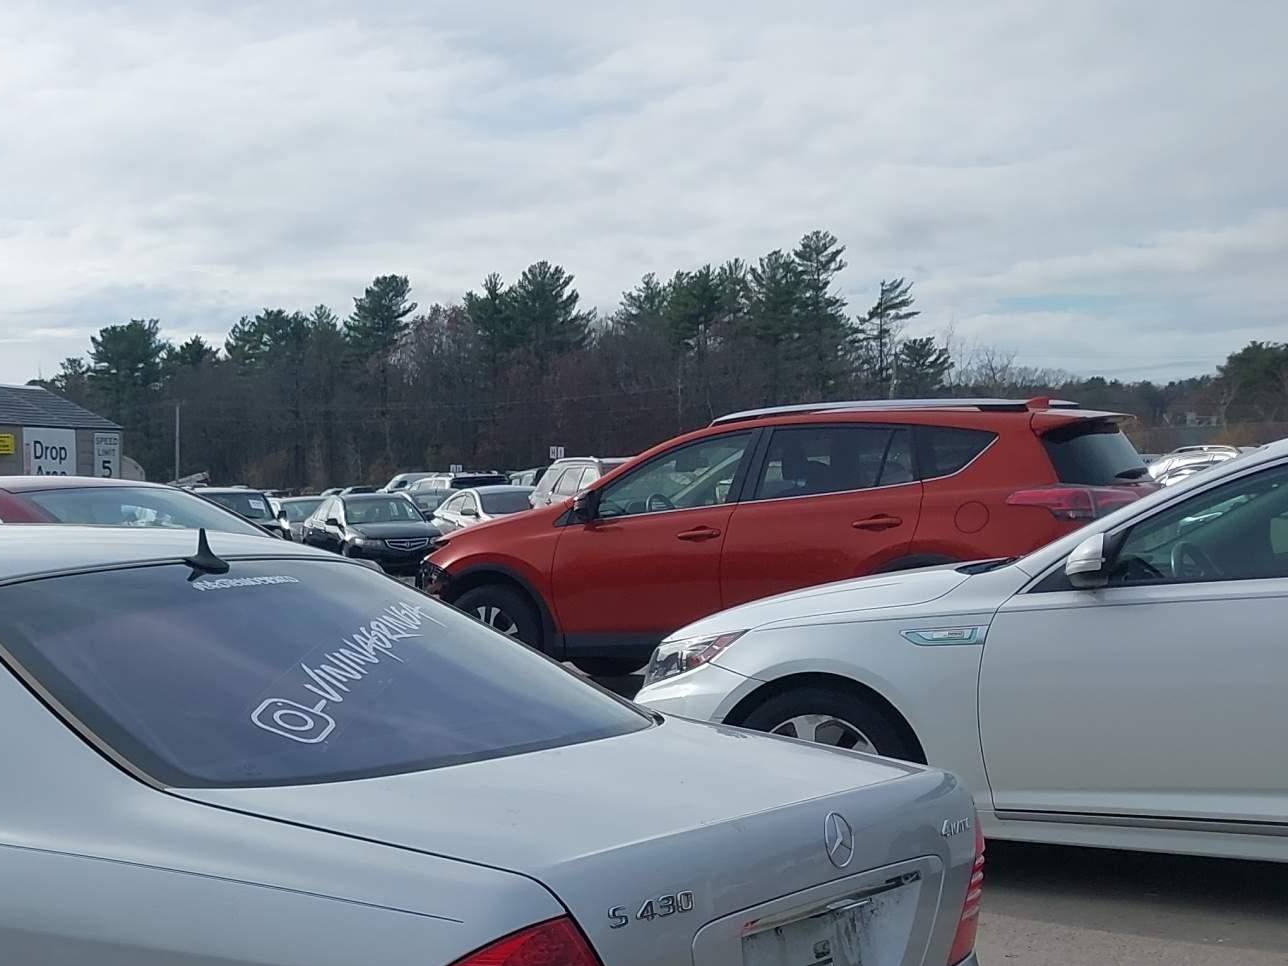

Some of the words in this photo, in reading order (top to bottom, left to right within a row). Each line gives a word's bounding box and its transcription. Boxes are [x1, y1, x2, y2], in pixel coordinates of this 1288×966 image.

[95, 437, 118, 446] SPEED
[33, 440, 67, 465] Drop
[102, 460, 113, 478] 5
[608, 904, 629, 929] S
[636, 890, 696, 921] 430
